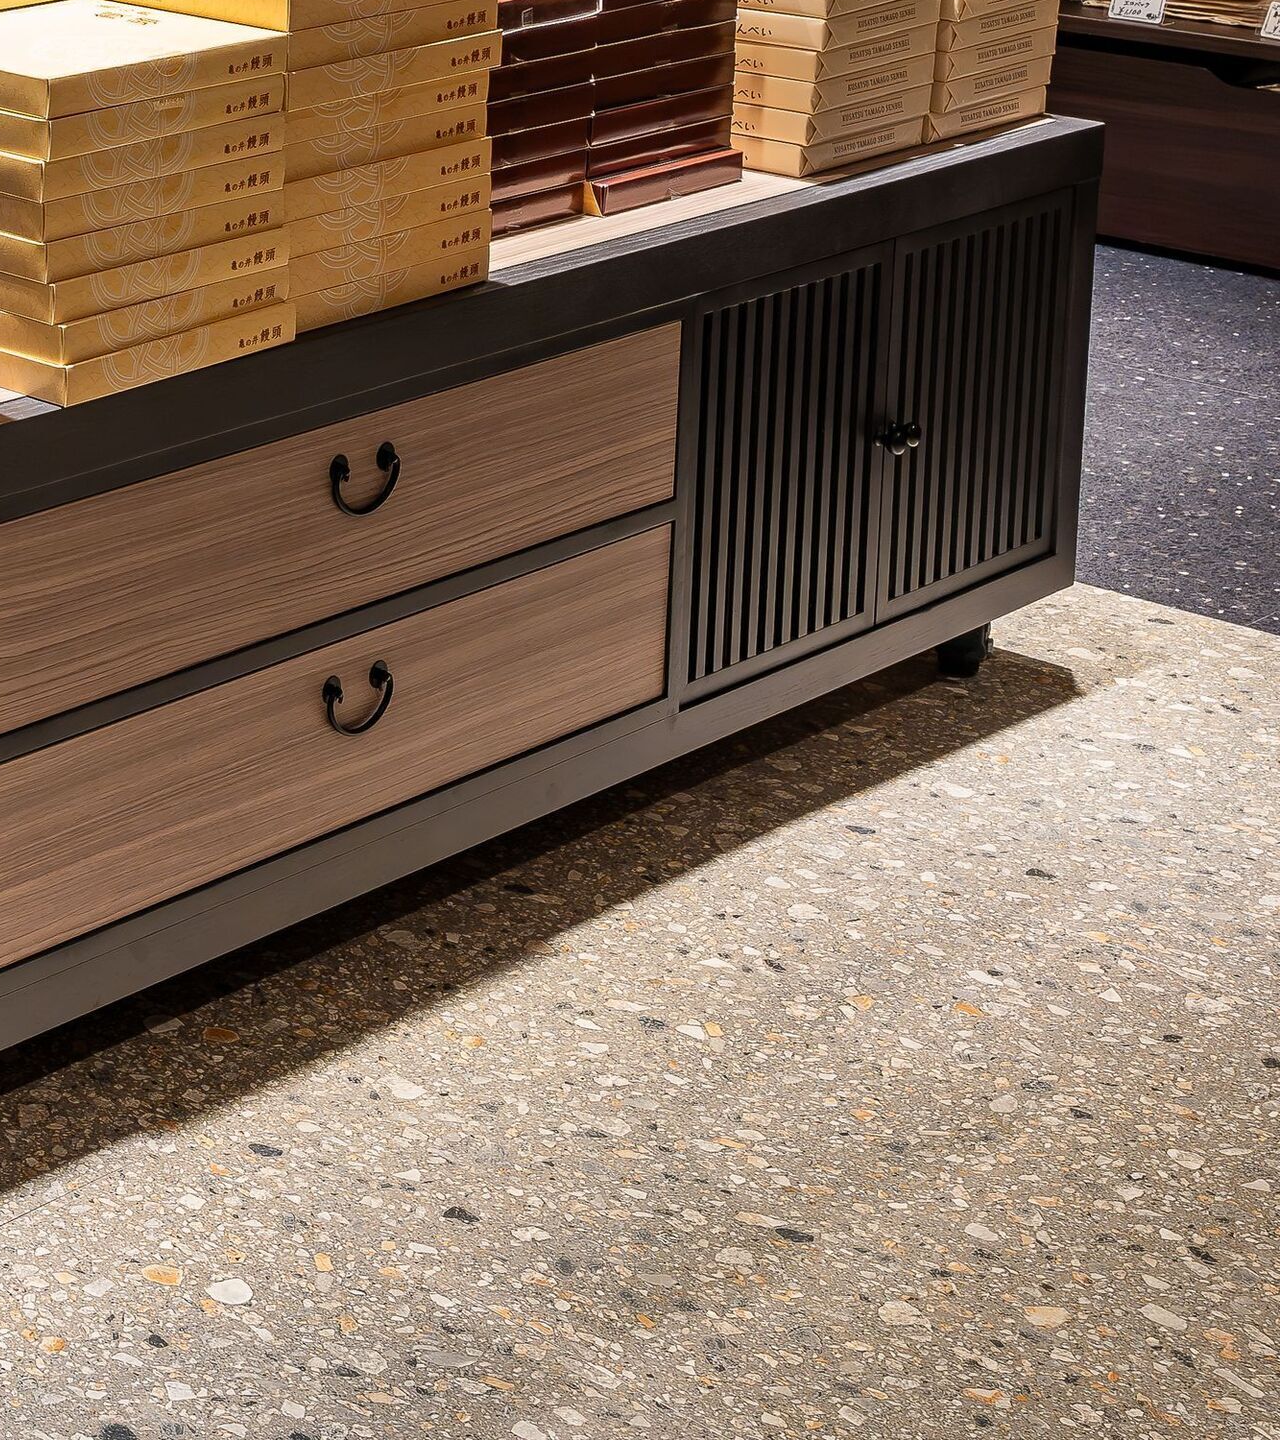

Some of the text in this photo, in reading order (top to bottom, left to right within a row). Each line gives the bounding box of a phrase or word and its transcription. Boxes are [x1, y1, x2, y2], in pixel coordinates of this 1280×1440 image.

[737, 24, 772, 36] んべい
[981, 11, 1035, 29] KUSATSU TAMAGO SENBEI
[849, 39, 910, 60] KUSATSU TAMAGO SENBEI
[229, 54, 272, 74] 亀の井饅頭
[847, 71, 907, 91] KUSATSU TAMAGO SENBEI
[226, 92, 270, 114] 亀の井饅頭
[437, 82, 477, 103] 亀の井饅頭
[961, 102, 1019, 123] KUSATSU TAMAGO SENBEI
[224, 132, 270, 154] 亀の井饅頭
[834, 133, 895, 154] KUSATSU TAMAGO SENBEI
[441, 154, 481, 175] 亀の井饅頭
[232, 248, 276, 270] 亀の井饅頭
[441, 262, 479, 285] 亀の井饅頭
[232, 284, 276, 308] 亀の井饅頭
[239, 324, 282, 349] 亀の井饅頭
